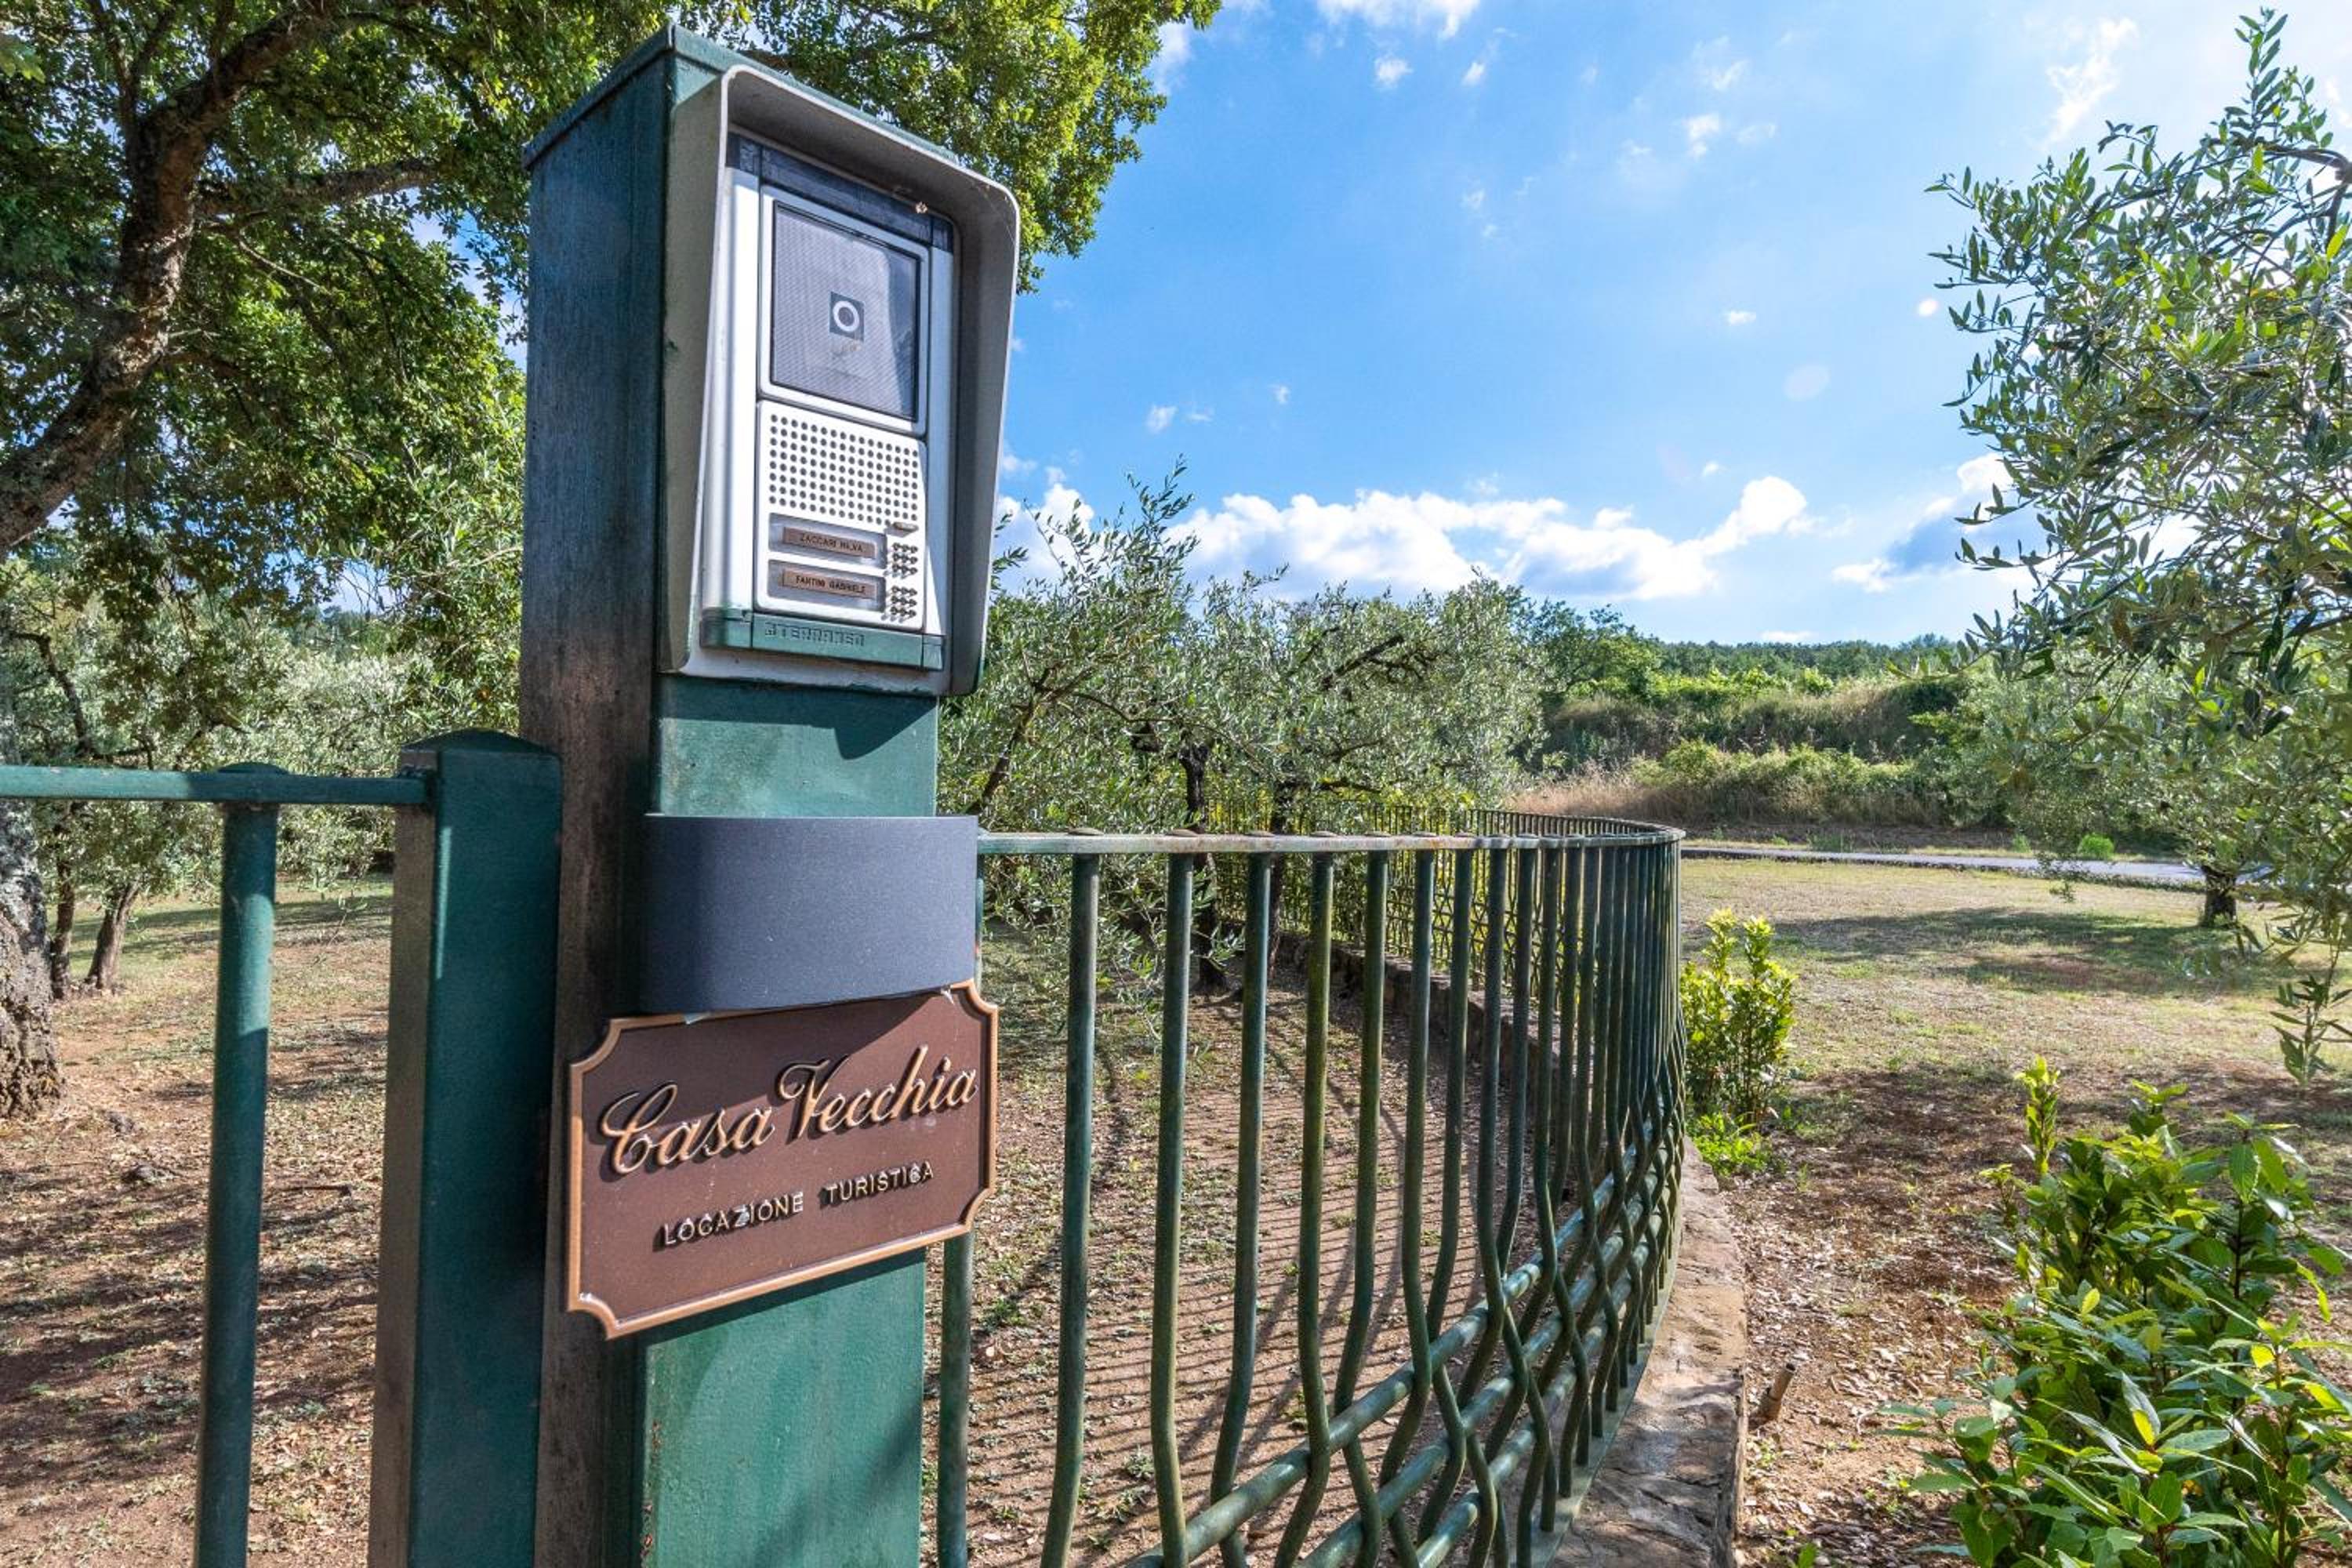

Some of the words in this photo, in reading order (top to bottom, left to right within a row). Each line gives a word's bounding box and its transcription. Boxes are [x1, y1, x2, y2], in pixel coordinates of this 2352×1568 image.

[602, 1081, 777, 1174] Casa
[779, 1044, 979, 1139] Vecchia
[662, 1191, 804, 1247] LOCAZIONE
[825, 1160, 935, 1204] TURISTICA
